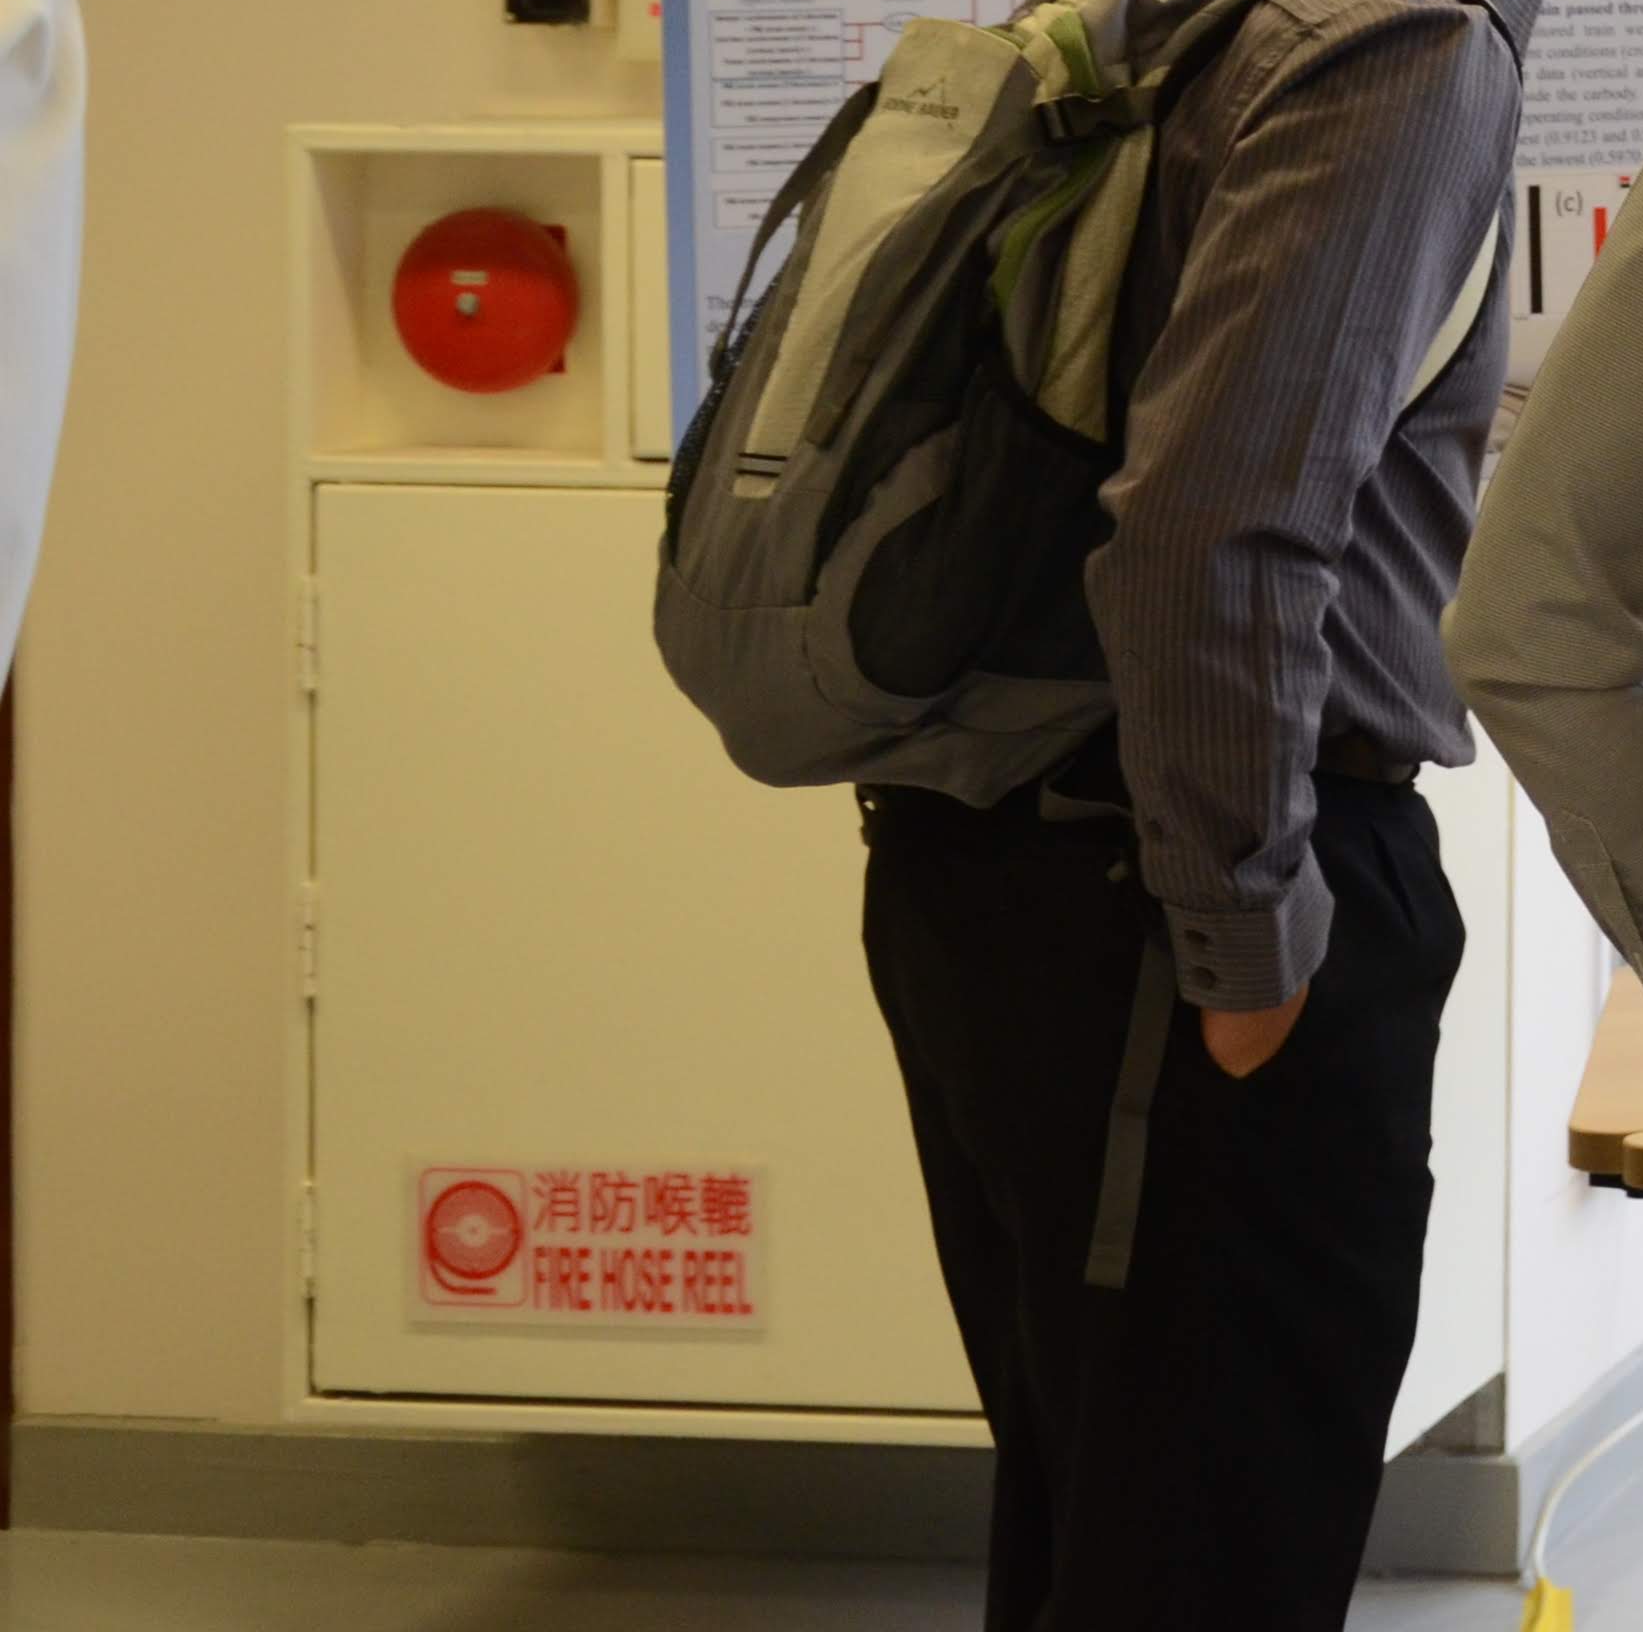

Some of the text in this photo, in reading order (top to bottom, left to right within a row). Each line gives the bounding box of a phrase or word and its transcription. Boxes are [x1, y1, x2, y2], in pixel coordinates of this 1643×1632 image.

[1555, 190, 1583, 216] (c)
[533, 1247, 754, 1315] FIRE HOSE REEL
